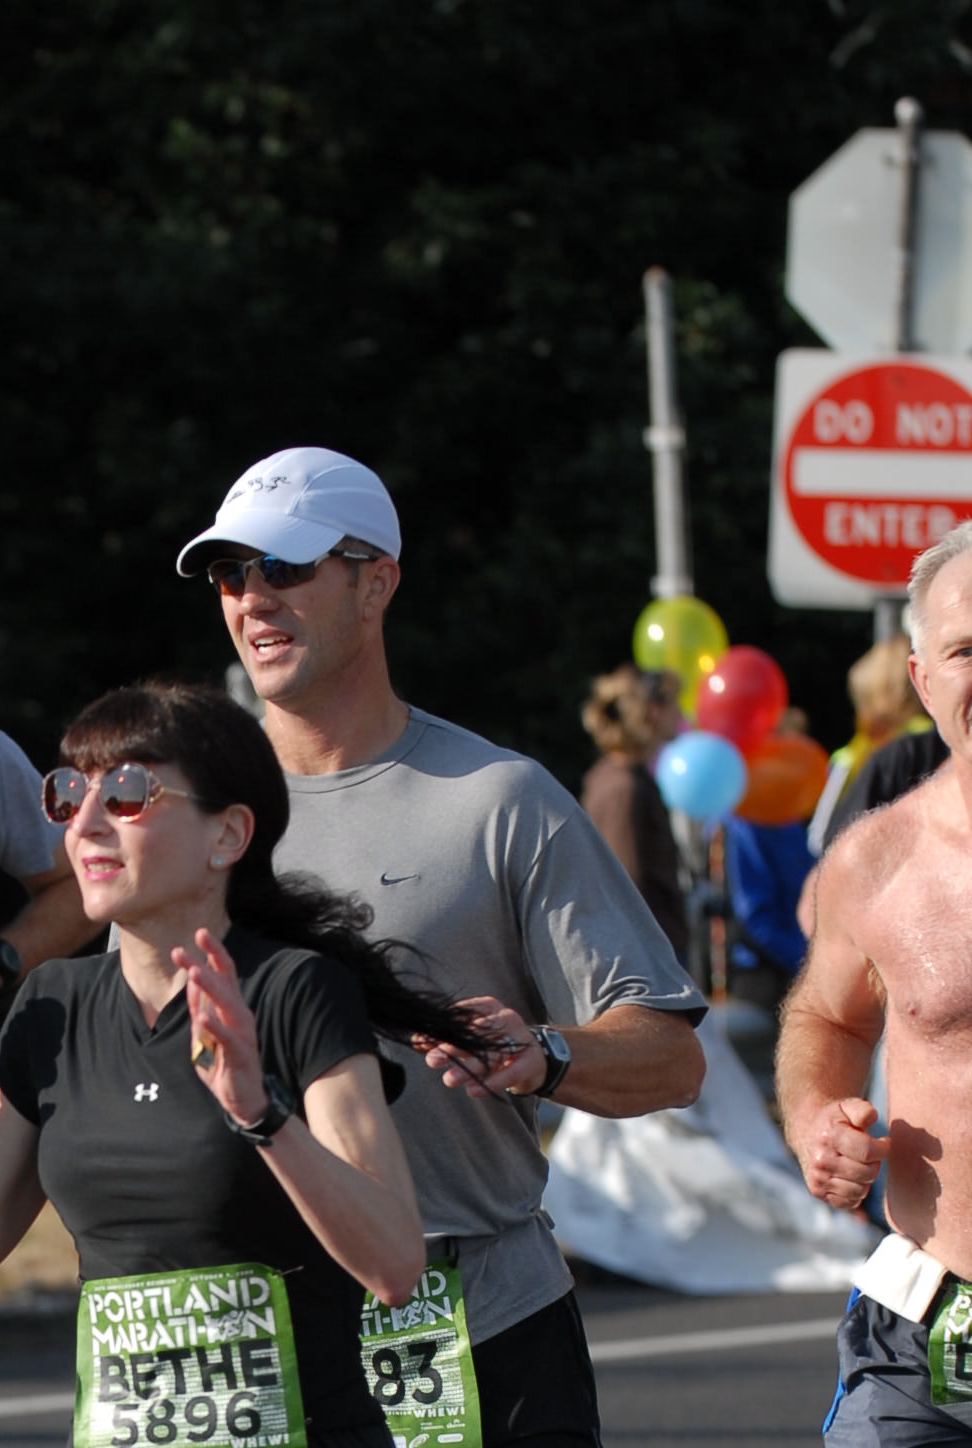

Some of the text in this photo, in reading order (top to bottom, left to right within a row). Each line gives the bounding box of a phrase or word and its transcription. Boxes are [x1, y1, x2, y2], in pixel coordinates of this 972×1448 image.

[813, 399, 972, 446] DO NOT
[825, 501, 957, 548] ENTER
[88, 1277, 270, 1324] PORTLAND
[99, 1338, 278, 1402] BETHE
[372, 1341, 443, 1405] 83
[111, 1391, 262, 1448] 5896
[413, 1406, 465, 1418] WHEW!
